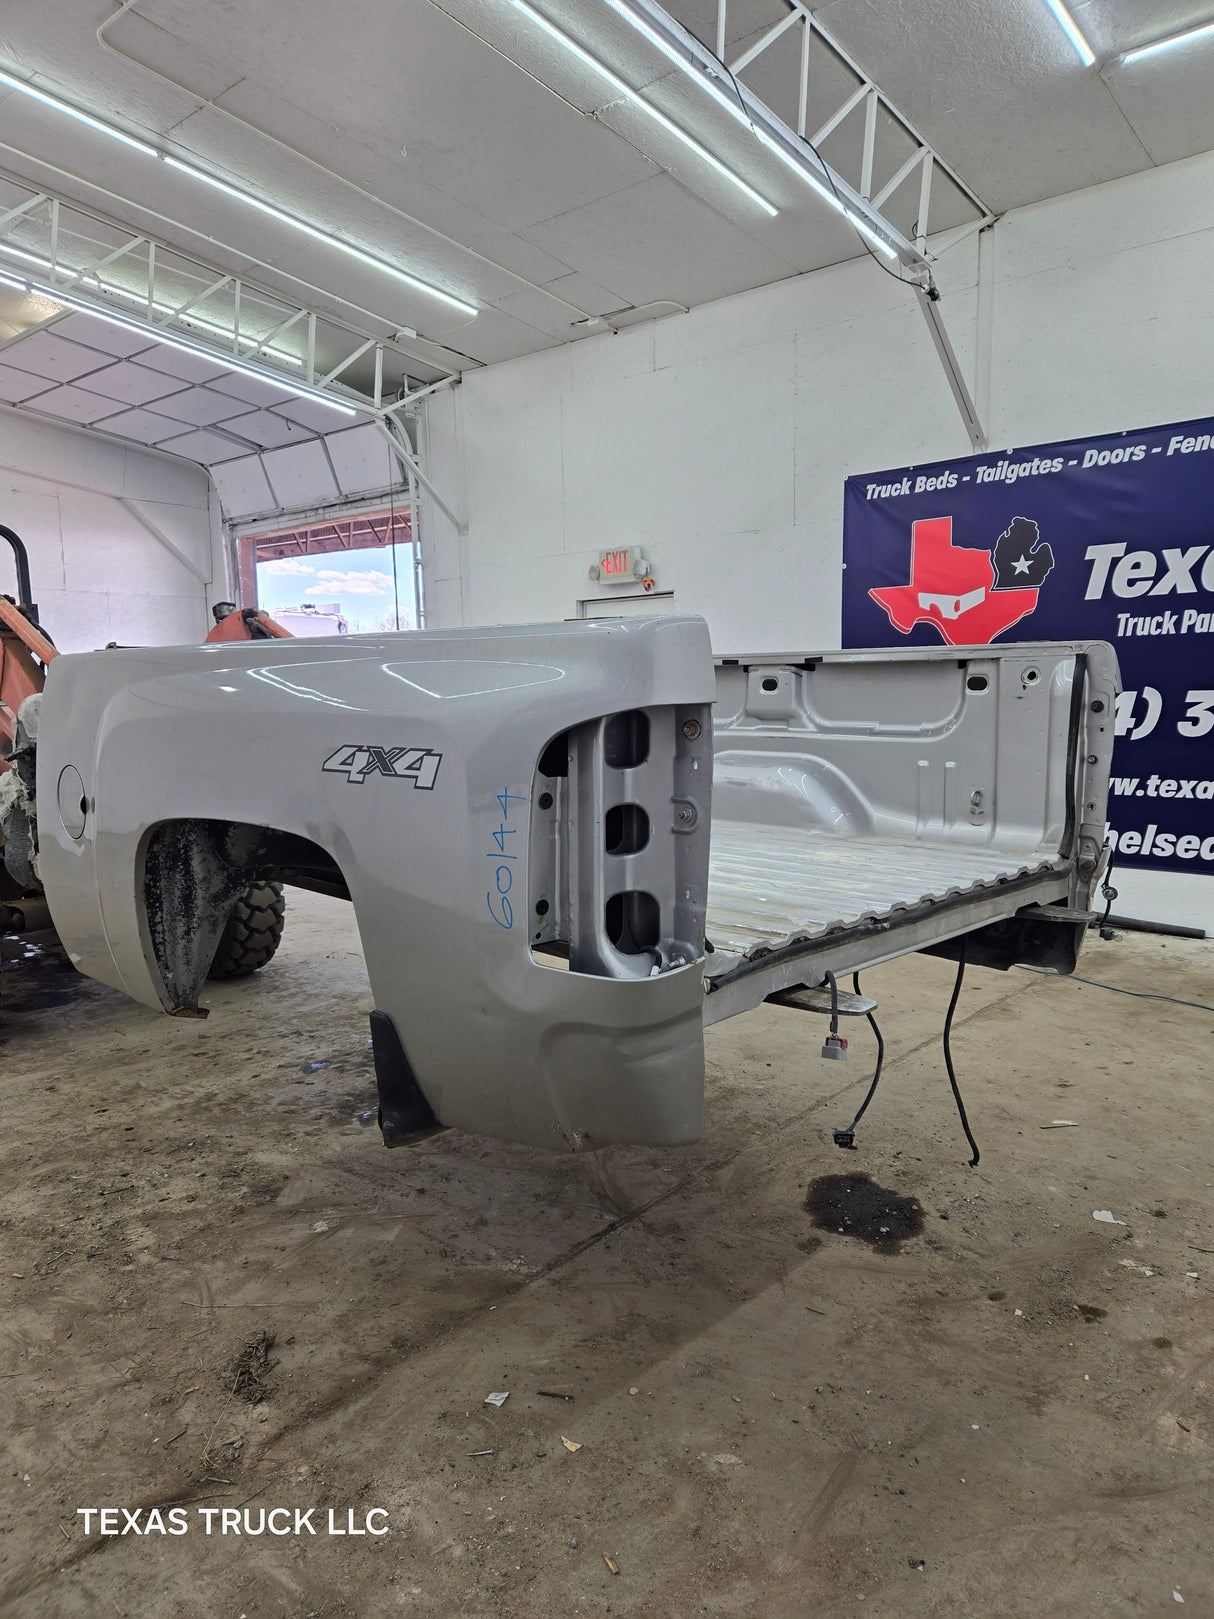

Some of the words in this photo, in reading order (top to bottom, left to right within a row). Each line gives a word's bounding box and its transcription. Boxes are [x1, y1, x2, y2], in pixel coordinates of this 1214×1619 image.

[866, 477, 913, 500] Truck
[914, 470, 958, 493] Beds
[976, 457, 1065, 484] Tailgates
[1082, 445, 1147, 468] Doors
[605, 550, 628, 575] EXIT
[1117, 610, 1179, 637] Truck
[487, 786, 526, 929] 60144
